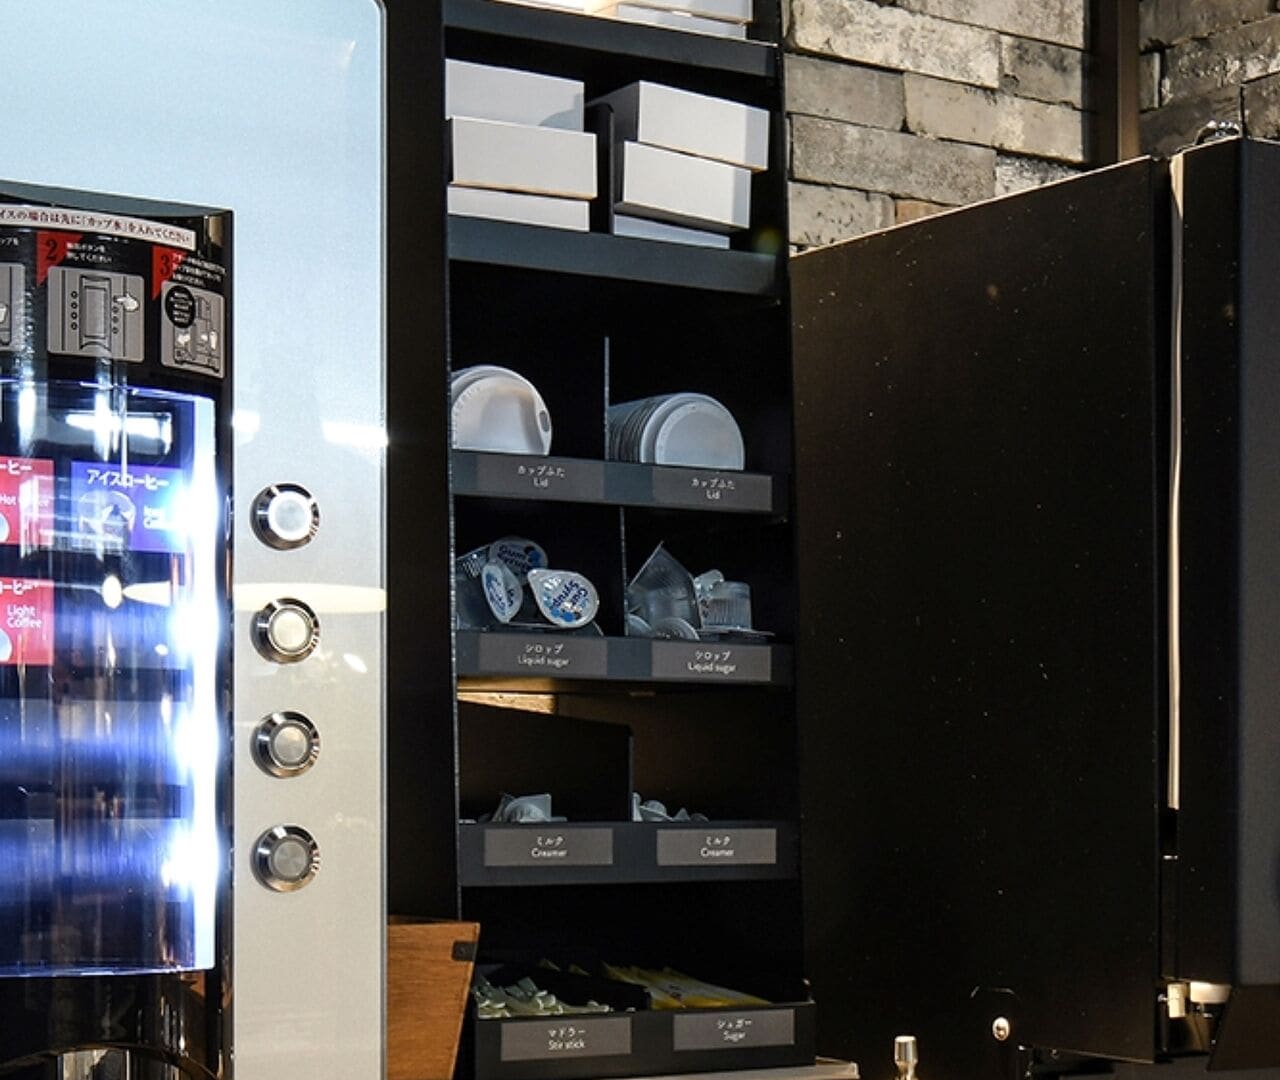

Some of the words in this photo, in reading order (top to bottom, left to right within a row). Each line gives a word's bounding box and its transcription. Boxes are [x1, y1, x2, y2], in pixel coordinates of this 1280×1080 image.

[46, 238, 58, 261] 2
[160, 254, 171, 277] 3
[518, 465, 566, 479] カップふた
[86, 469, 170, 491] アイスコーヒー
[533, 477, 549, 488] Lid
[691, 478, 736, 490] カップふた
[706, 489, 721, 500] Lid
[6, 604, 36, 619] Light
[6, 617, 42, 629] Coffee
[525, 644, 564, 655] シロップ
[517, 654, 546, 667] Liquid
[694, 650, 731, 661] シロップ
[687, 662, 713, 673] Liquid
[537, 836, 564, 847] ミルク
[705, 836, 730, 847] ミルク
[531, 847, 568, 858] Creamer
[700, 847, 735, 858] Creamer
[717, 1019, 752, 1030] シュガー
[548, 1027, 586, 1038] マドラー
[723, 1030, 746, 1043] Sugar
[548, 1040, 563, 1050] Stir
[564, 1038, 586, 1049] stick
